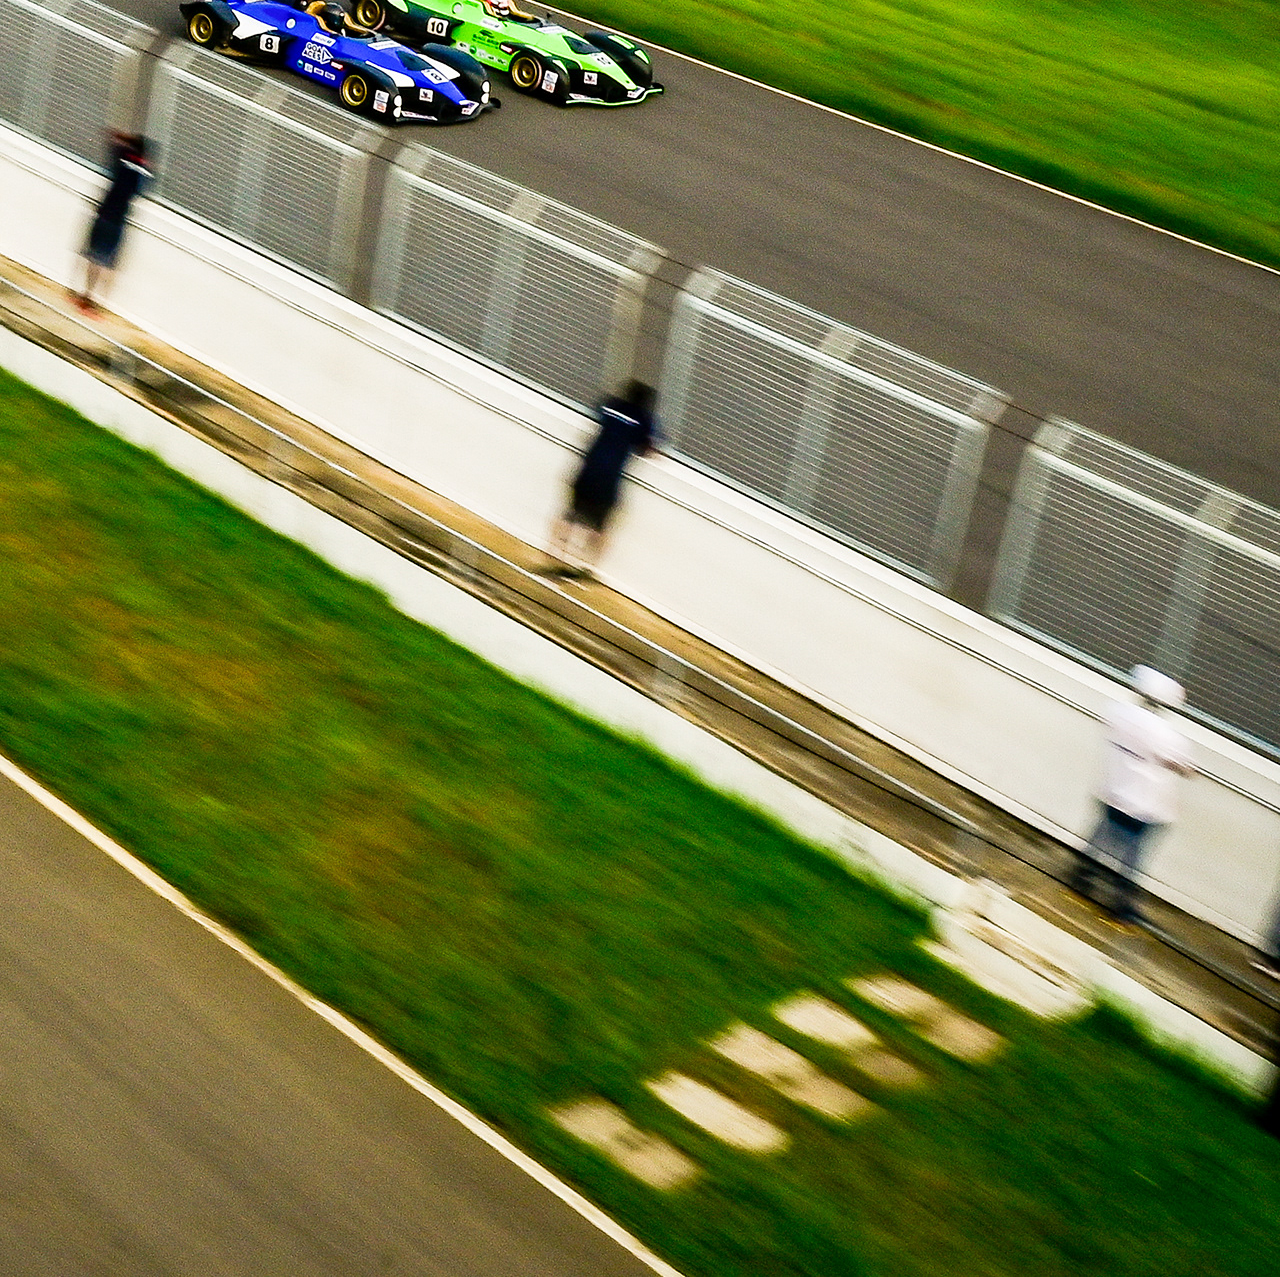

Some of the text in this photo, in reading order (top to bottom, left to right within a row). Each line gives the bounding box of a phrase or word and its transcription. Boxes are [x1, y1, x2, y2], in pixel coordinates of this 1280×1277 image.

[431, 20, 444, 34] 10
[264, 37, 274, 50] 8
[306, 43, 321, 53] GOA
[303, 50, 321, 60] ACES
